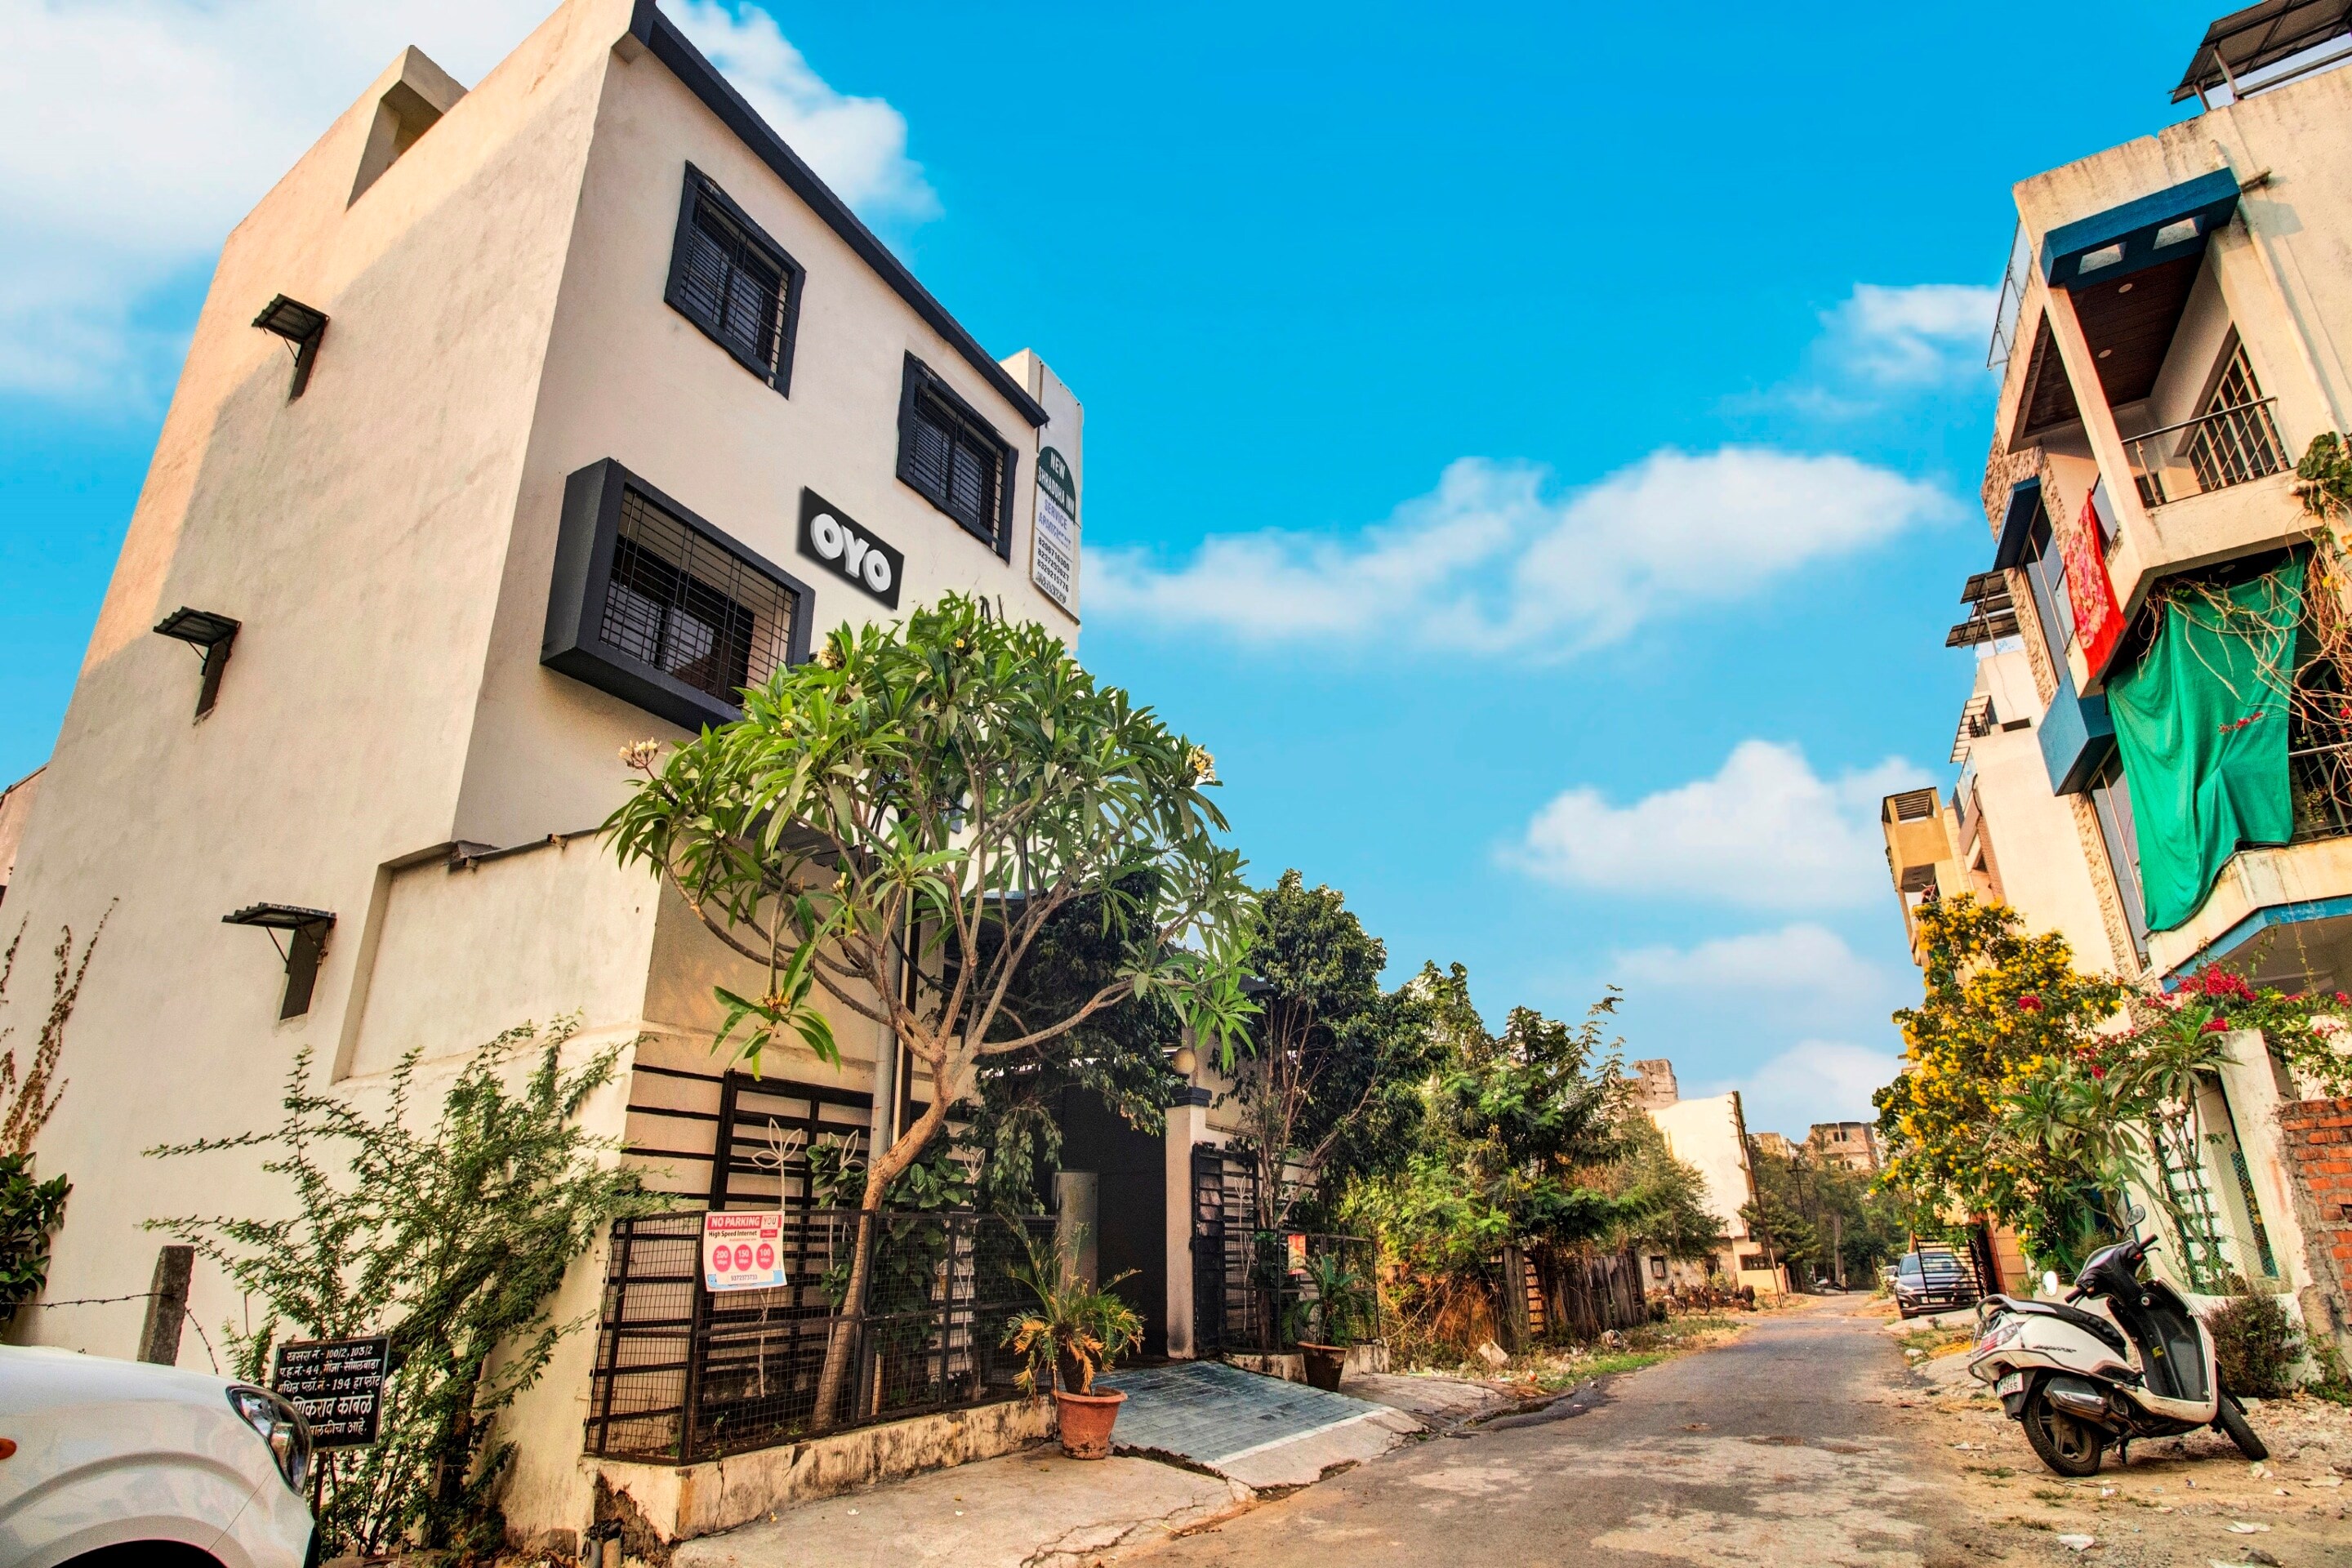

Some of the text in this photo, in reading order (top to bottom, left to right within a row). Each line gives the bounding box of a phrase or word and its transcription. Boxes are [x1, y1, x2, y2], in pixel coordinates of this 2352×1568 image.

[1049, 451, 1066, 480] NEW
[1037, 466, 1075, 516] SHRADDHA INN
[1044, 499, 1067, 530] SERVICE
[810, 513, 892, 593] OYO
[711, 1216, 760, 1227] NO PARKING
[764, 1217, 777, 1226] YOU
[708, 1230, 720, 1239] High
[721, 1230, 737, 1239] Speed
[737, 1229, 757, 1237] Internet
[716, 1250, 728, 1258] 200
[737, 1249, 750, 1258] 150
[760, 1248, 771, 1256] 100
